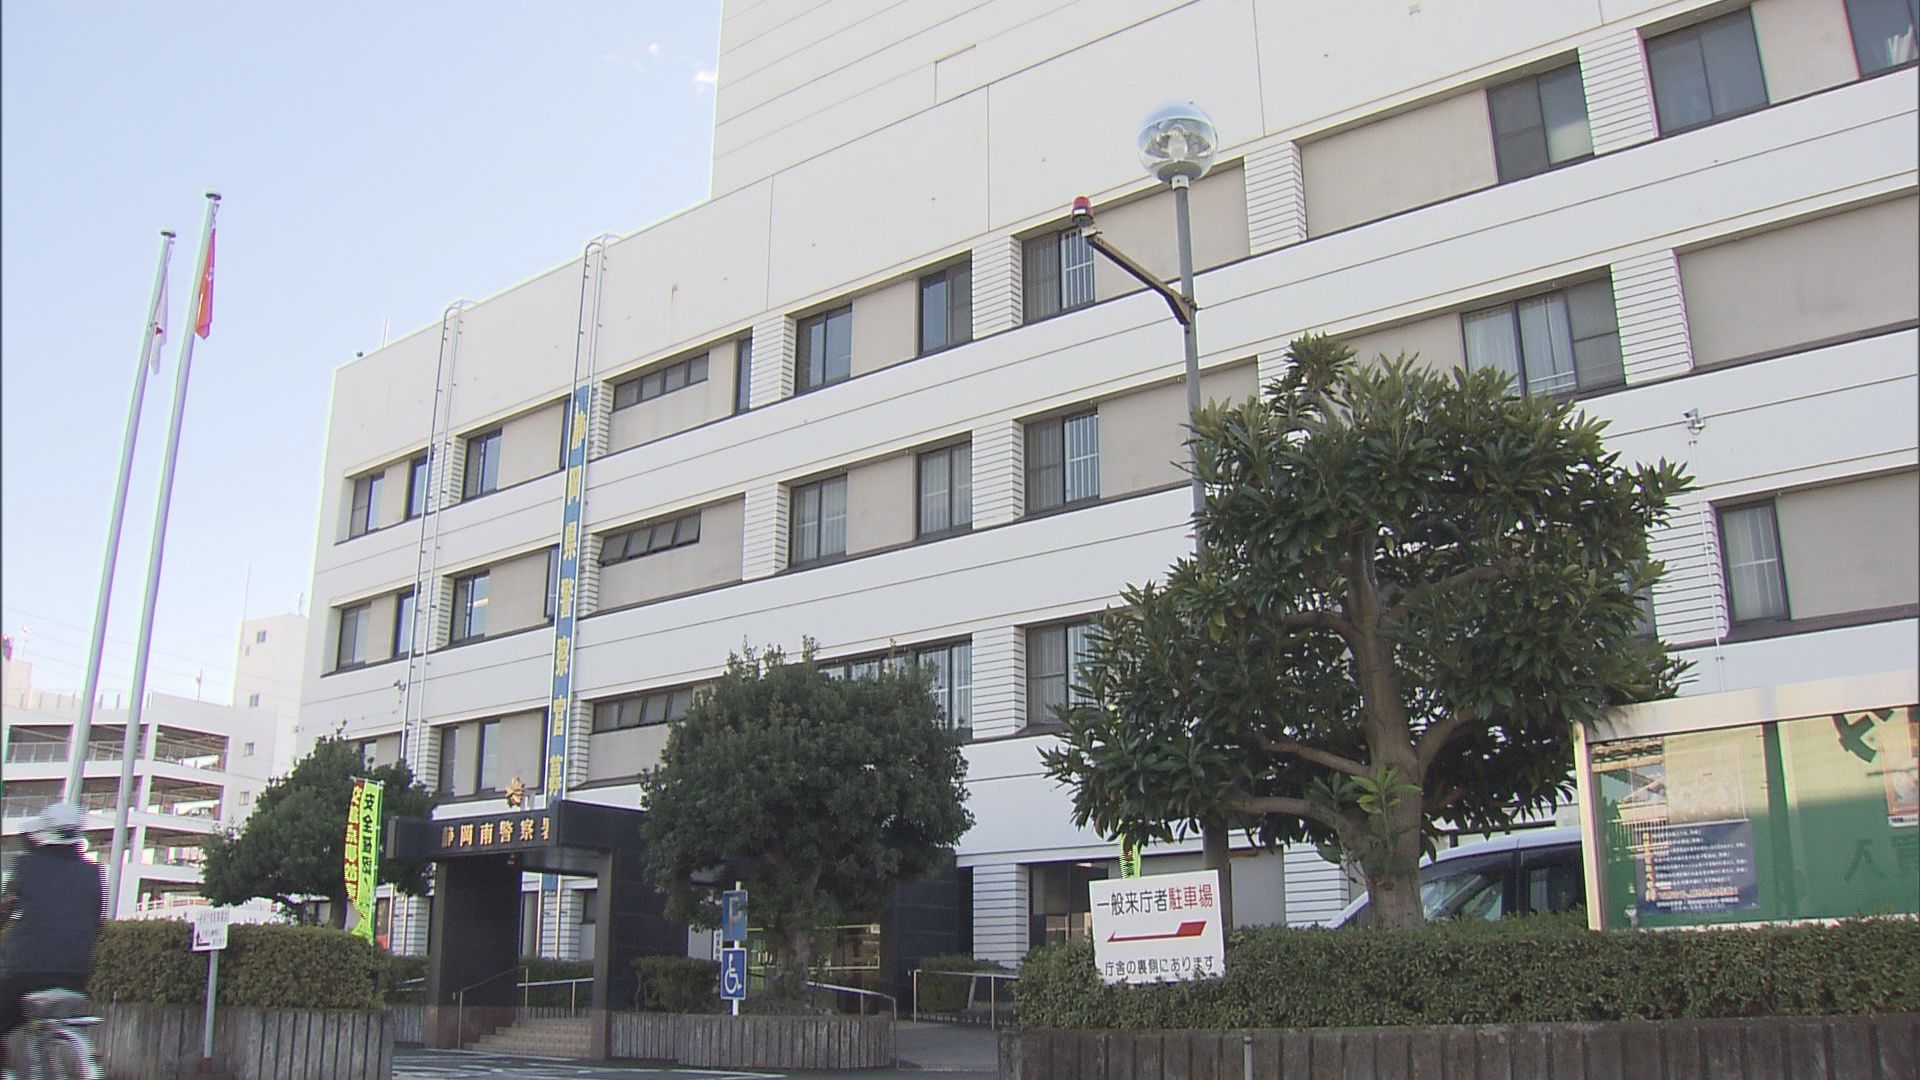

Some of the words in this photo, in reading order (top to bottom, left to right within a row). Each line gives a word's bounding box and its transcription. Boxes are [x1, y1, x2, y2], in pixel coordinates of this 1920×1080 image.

[729, 896, 742, 936] P
[1096, 884, 1213, 916] 一般来庁者駐車場
[1105, 955, 1214, 977] 庁舎の裏側にあります
